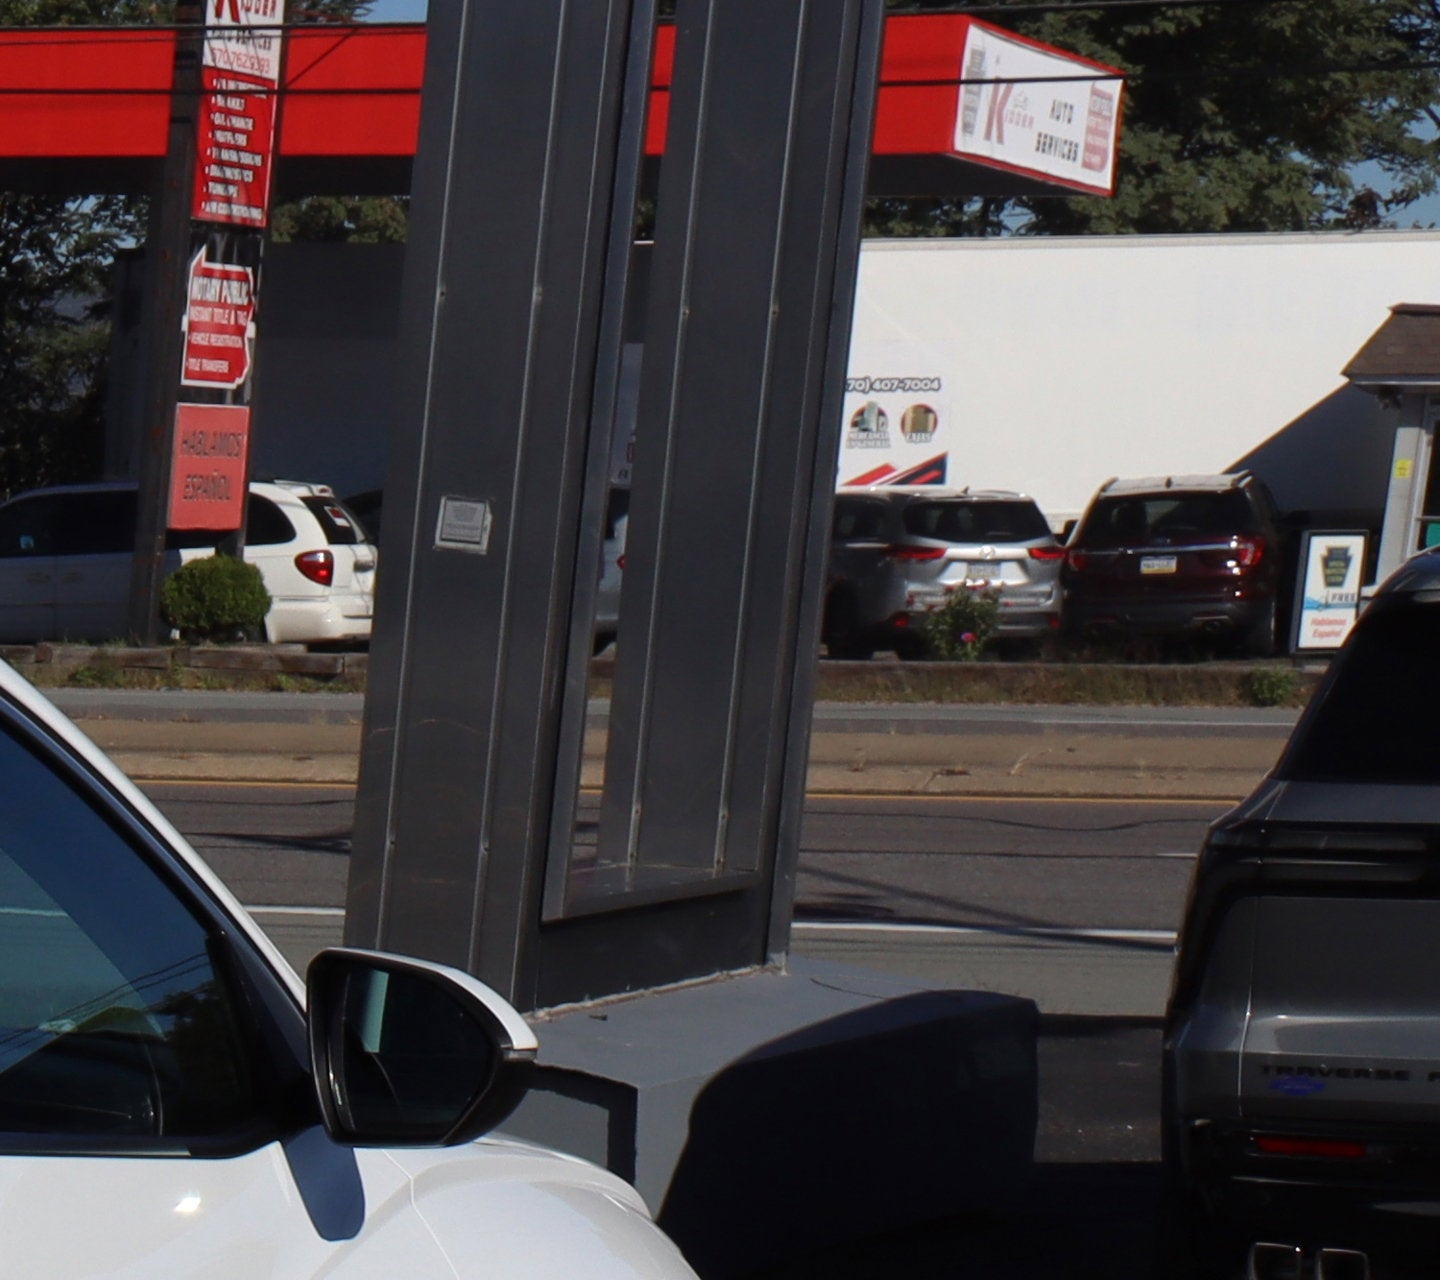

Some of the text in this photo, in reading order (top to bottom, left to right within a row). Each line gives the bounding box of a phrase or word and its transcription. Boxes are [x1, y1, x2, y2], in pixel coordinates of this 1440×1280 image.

[1049, 99, 1074, 124] AUTO
[1035, 132, 1079, 162] SERVICES
[191, 276, 249, 306] NOTARY PUBLIC
[871, 377, 941, 391] 407-7004
[182, 431, 244, 457] HABLAMOS
[183, 469, 231, 501] ESPAÑOL
[1331, 593, 1356, 602] FREE
[1259, 1065, 1410, 1081] TRAVERSE
